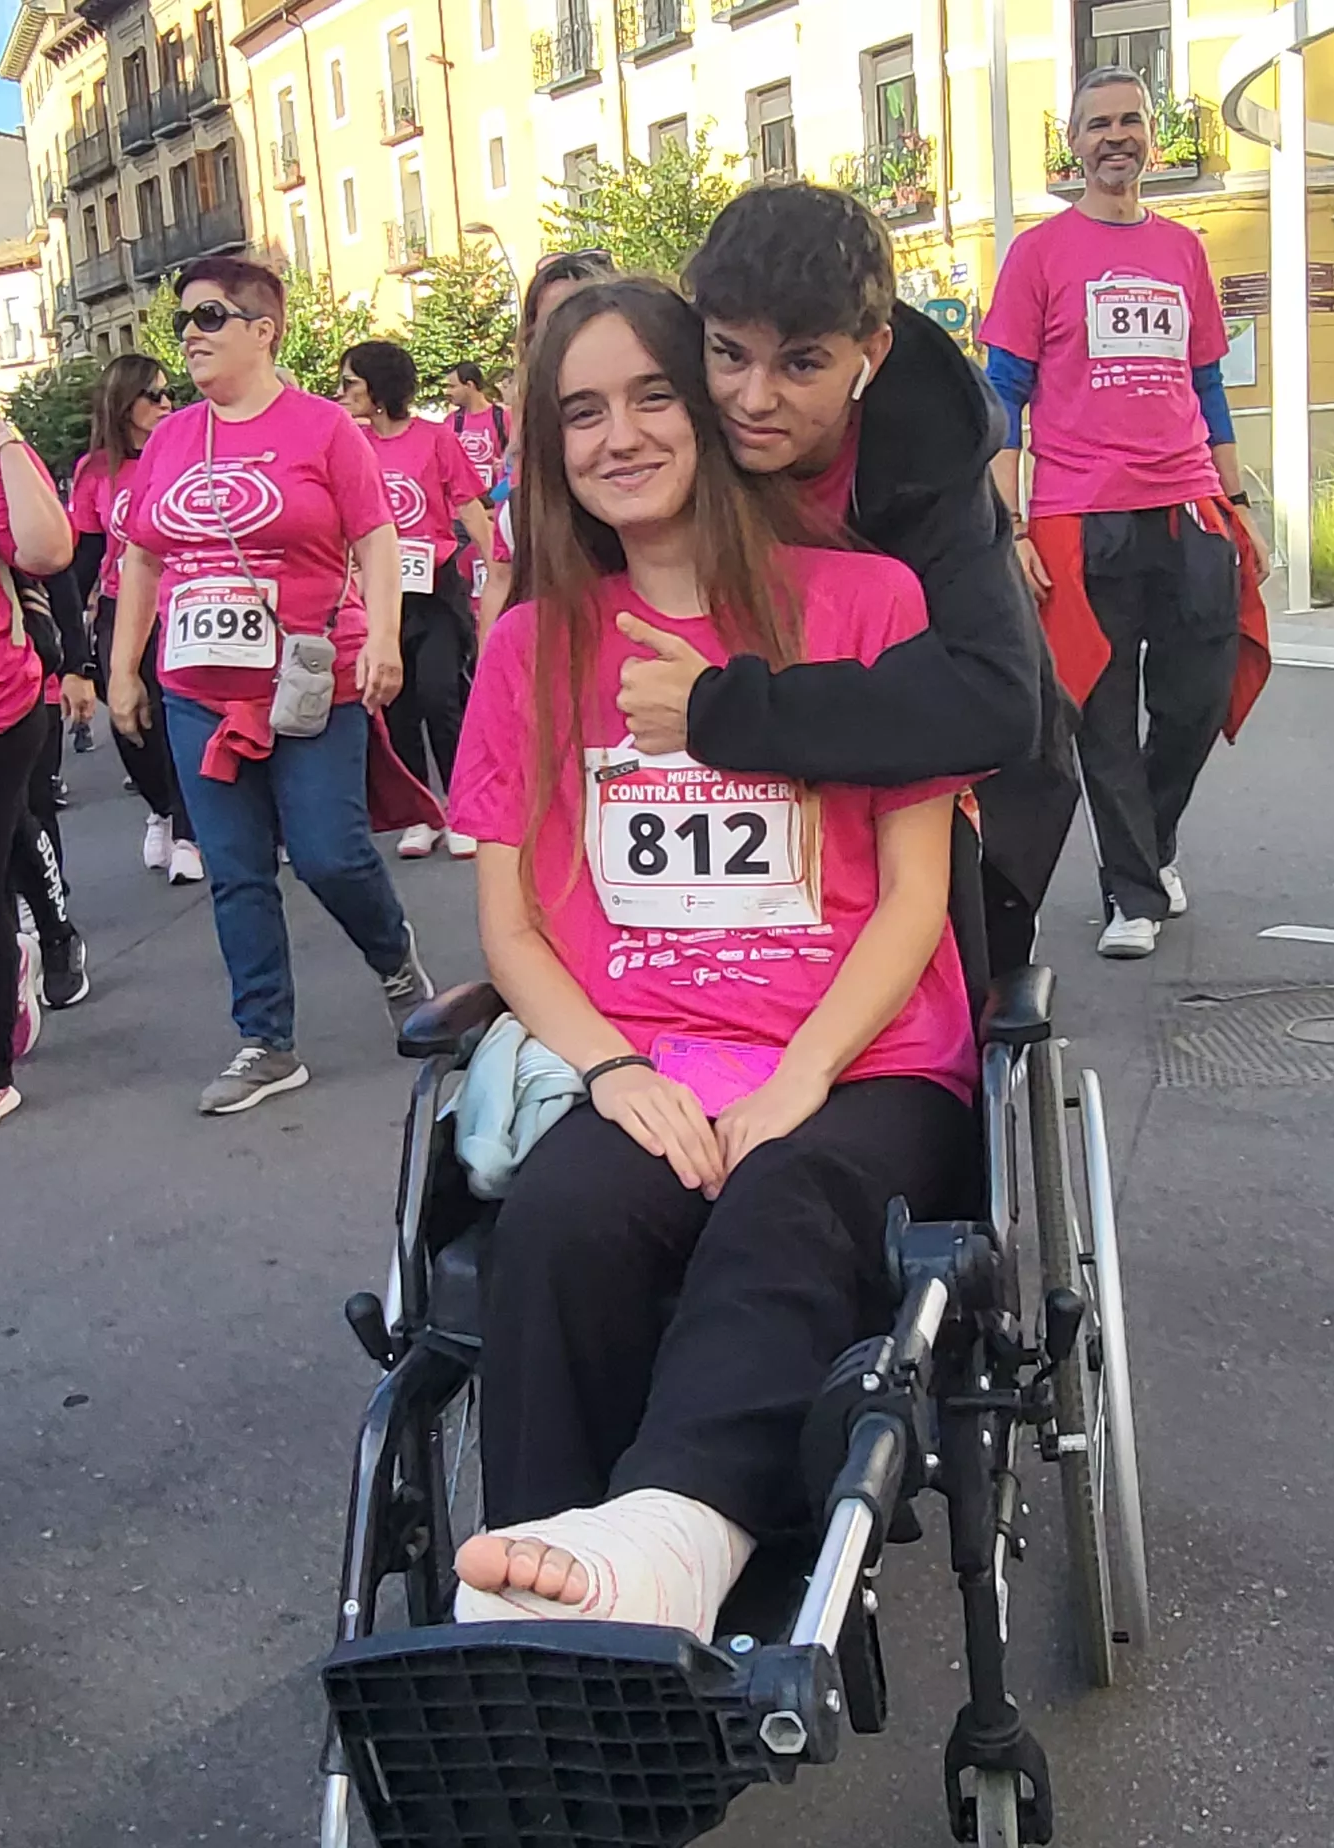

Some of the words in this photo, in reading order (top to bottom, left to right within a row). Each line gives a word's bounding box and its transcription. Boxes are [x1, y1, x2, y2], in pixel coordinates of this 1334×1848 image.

[1111, 307, 1172, 335] 814
[177, 608, 263, 642] 1698
[667, 769, 722, 783] HUESCA
[608, 784, 680, 801] CONTRA
[685, 785, 707, 801] EL
[711, 780, 791, 801] CÁNCER
[628, 811, 770, 876] 812
